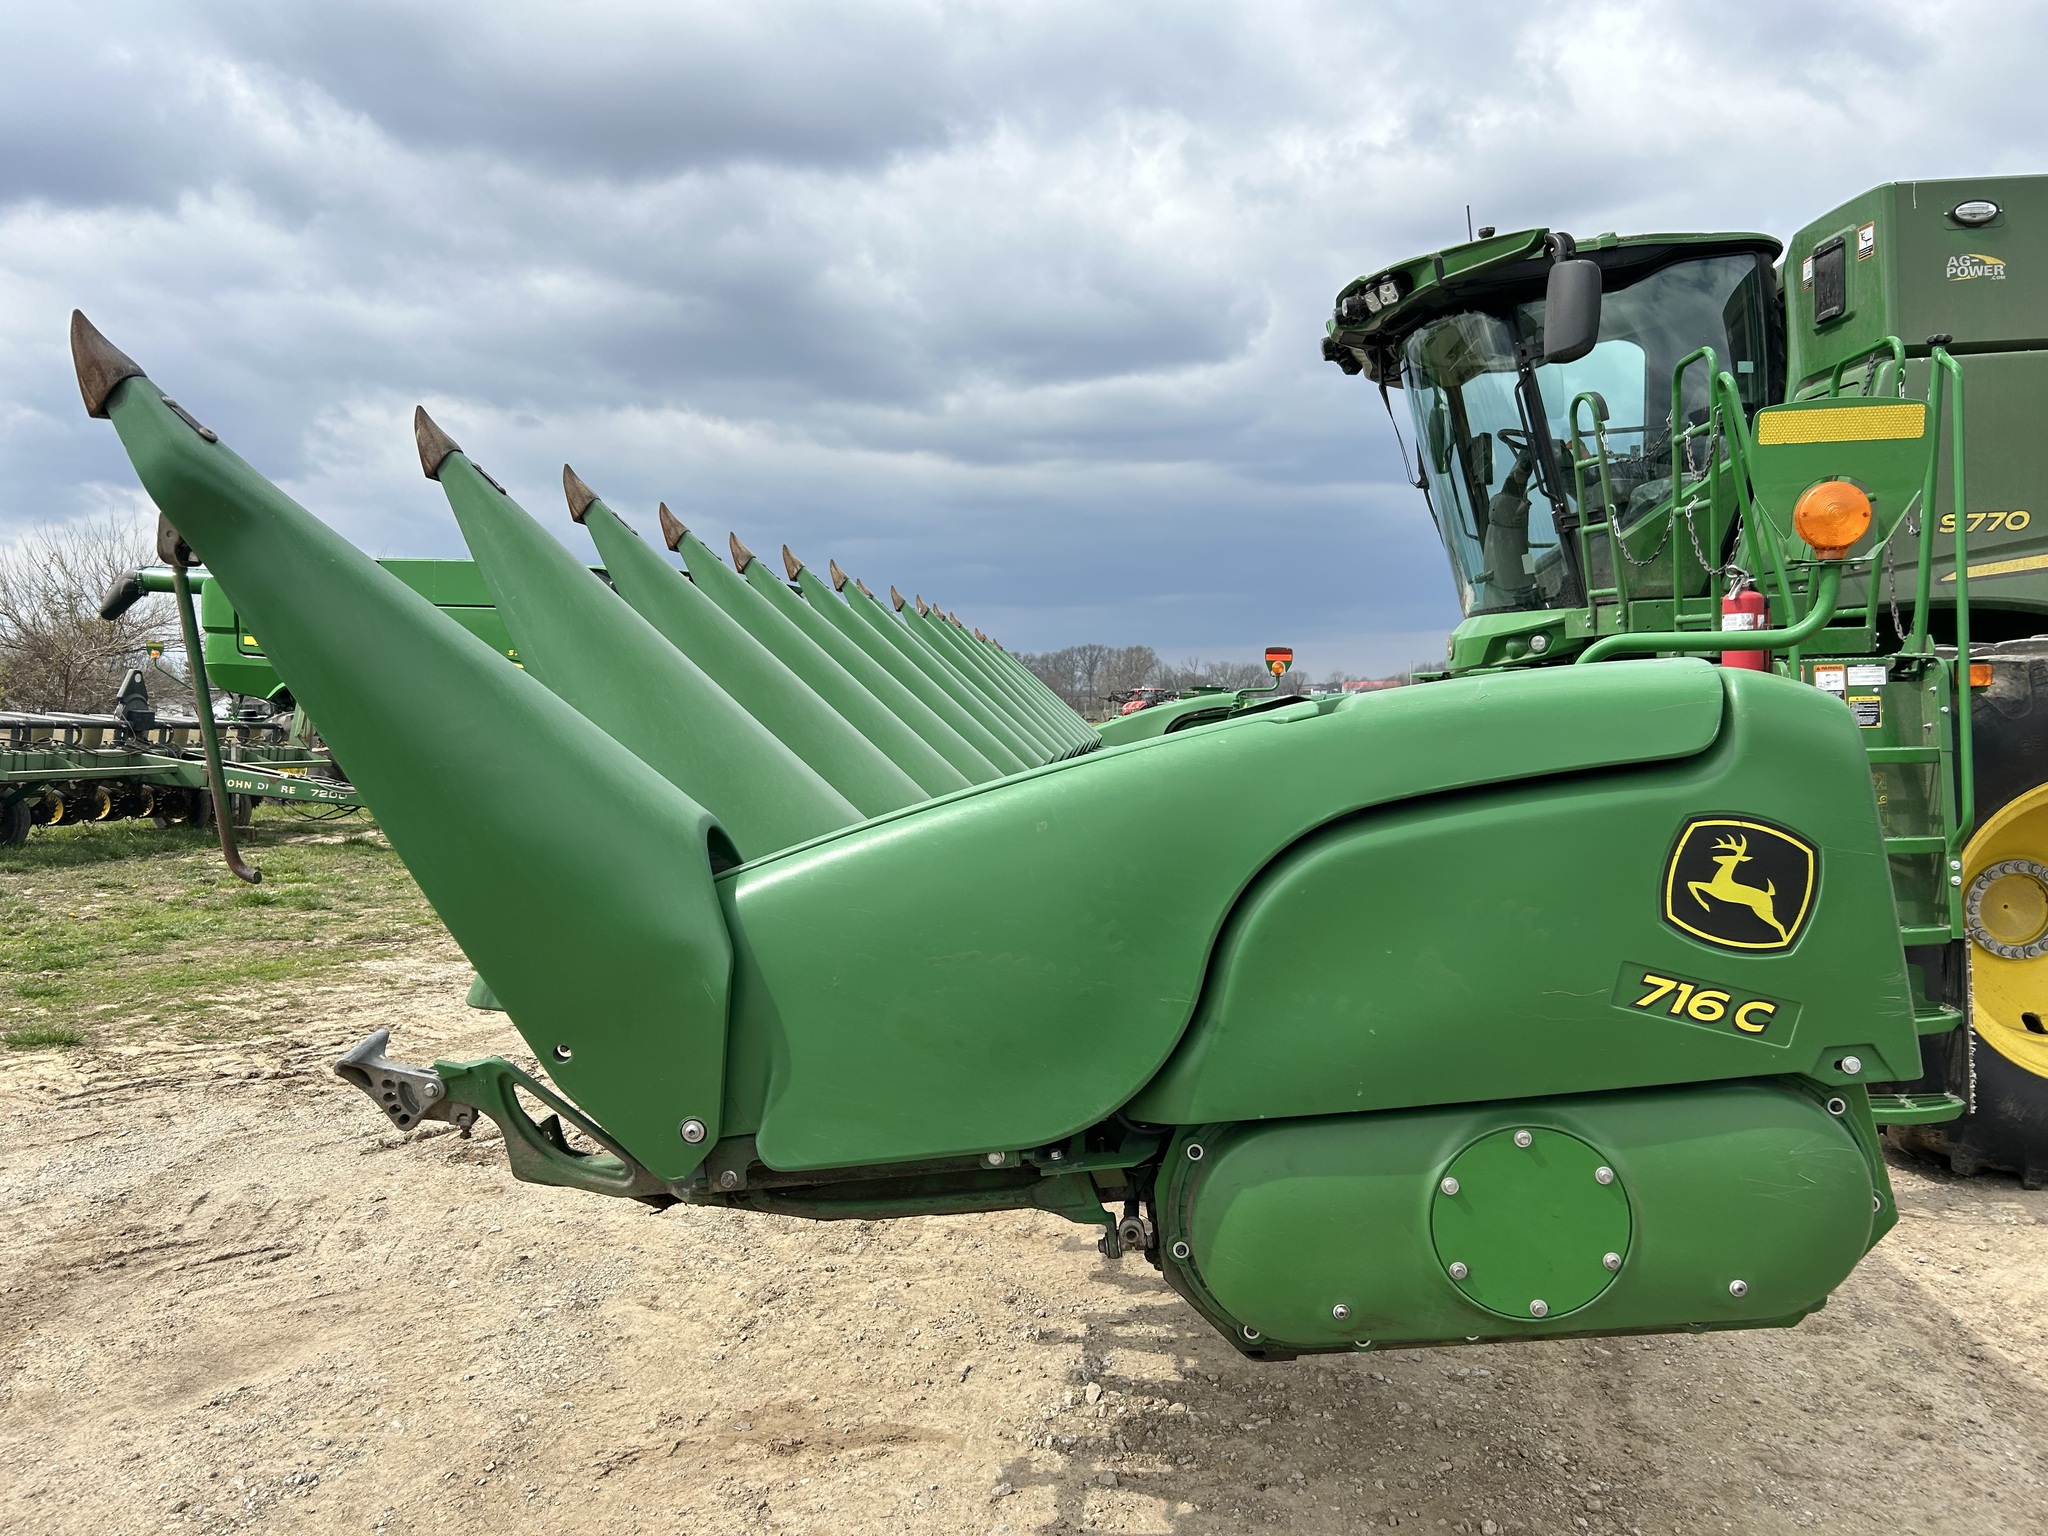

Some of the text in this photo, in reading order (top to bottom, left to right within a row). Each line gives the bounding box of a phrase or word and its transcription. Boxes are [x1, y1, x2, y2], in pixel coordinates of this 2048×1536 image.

[1946, 255, 1980, 267] AG-
[1946, 264, 2005, 278] POWER
[1938, 509, 2032, 534] S770
[224, 778, 252, 789] OHN
[1631, 973, 1777, 1034] 716 C
